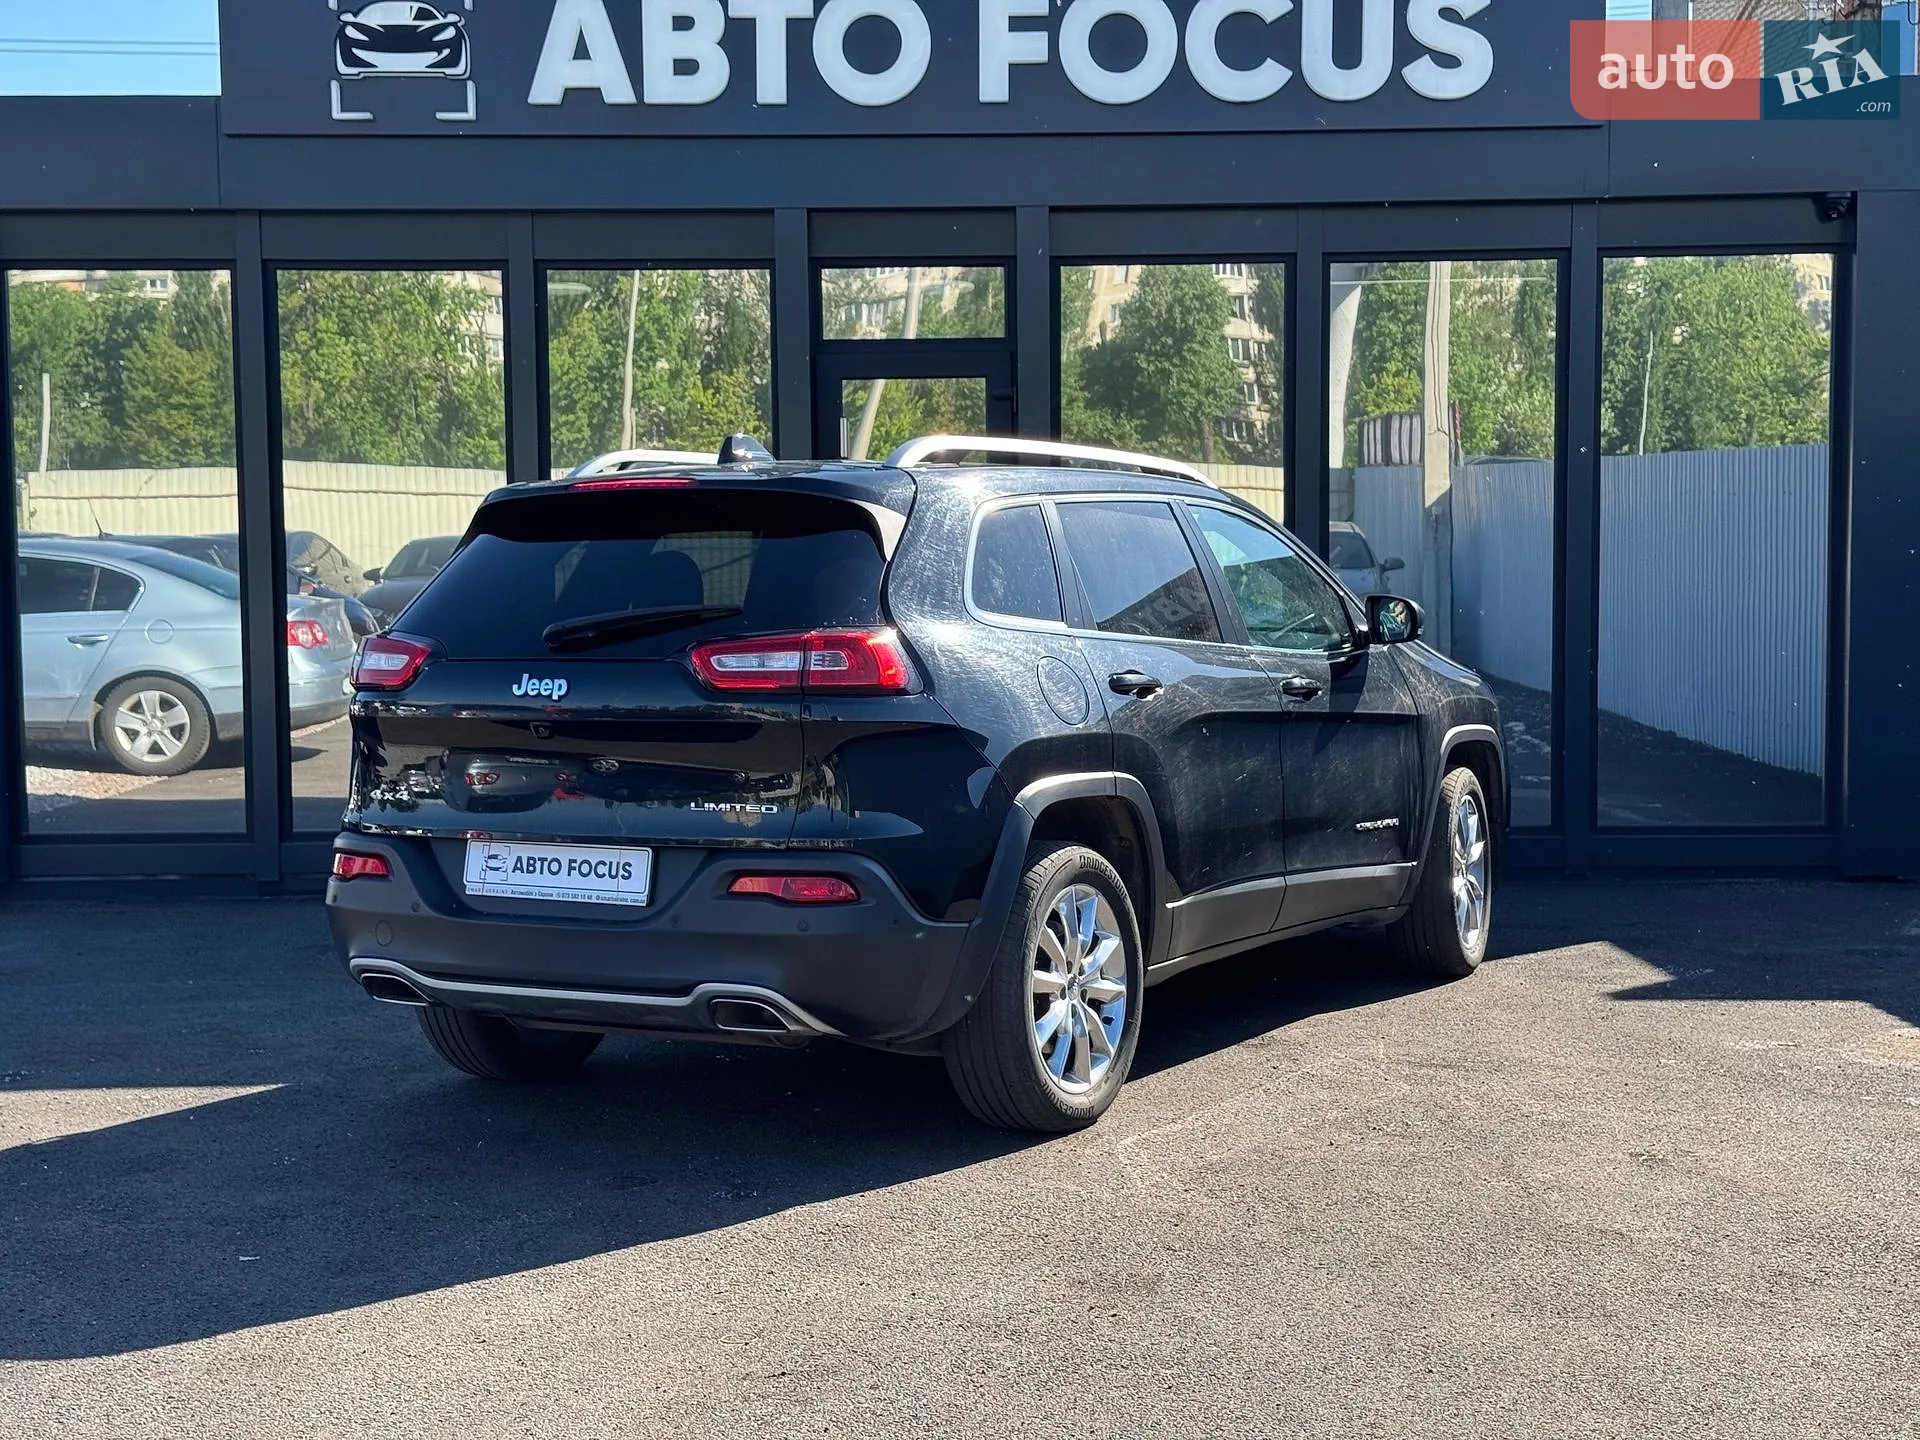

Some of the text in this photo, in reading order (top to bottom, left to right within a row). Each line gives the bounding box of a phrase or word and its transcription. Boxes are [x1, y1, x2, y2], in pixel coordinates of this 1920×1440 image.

[528, 0, 1494, 105] АВТО FOCUS
[512, 673, 568, 700] Jeep
[690, 802, 778, 814] LIMITED
[512, 855, 633, 880] АВТО FOCUS
